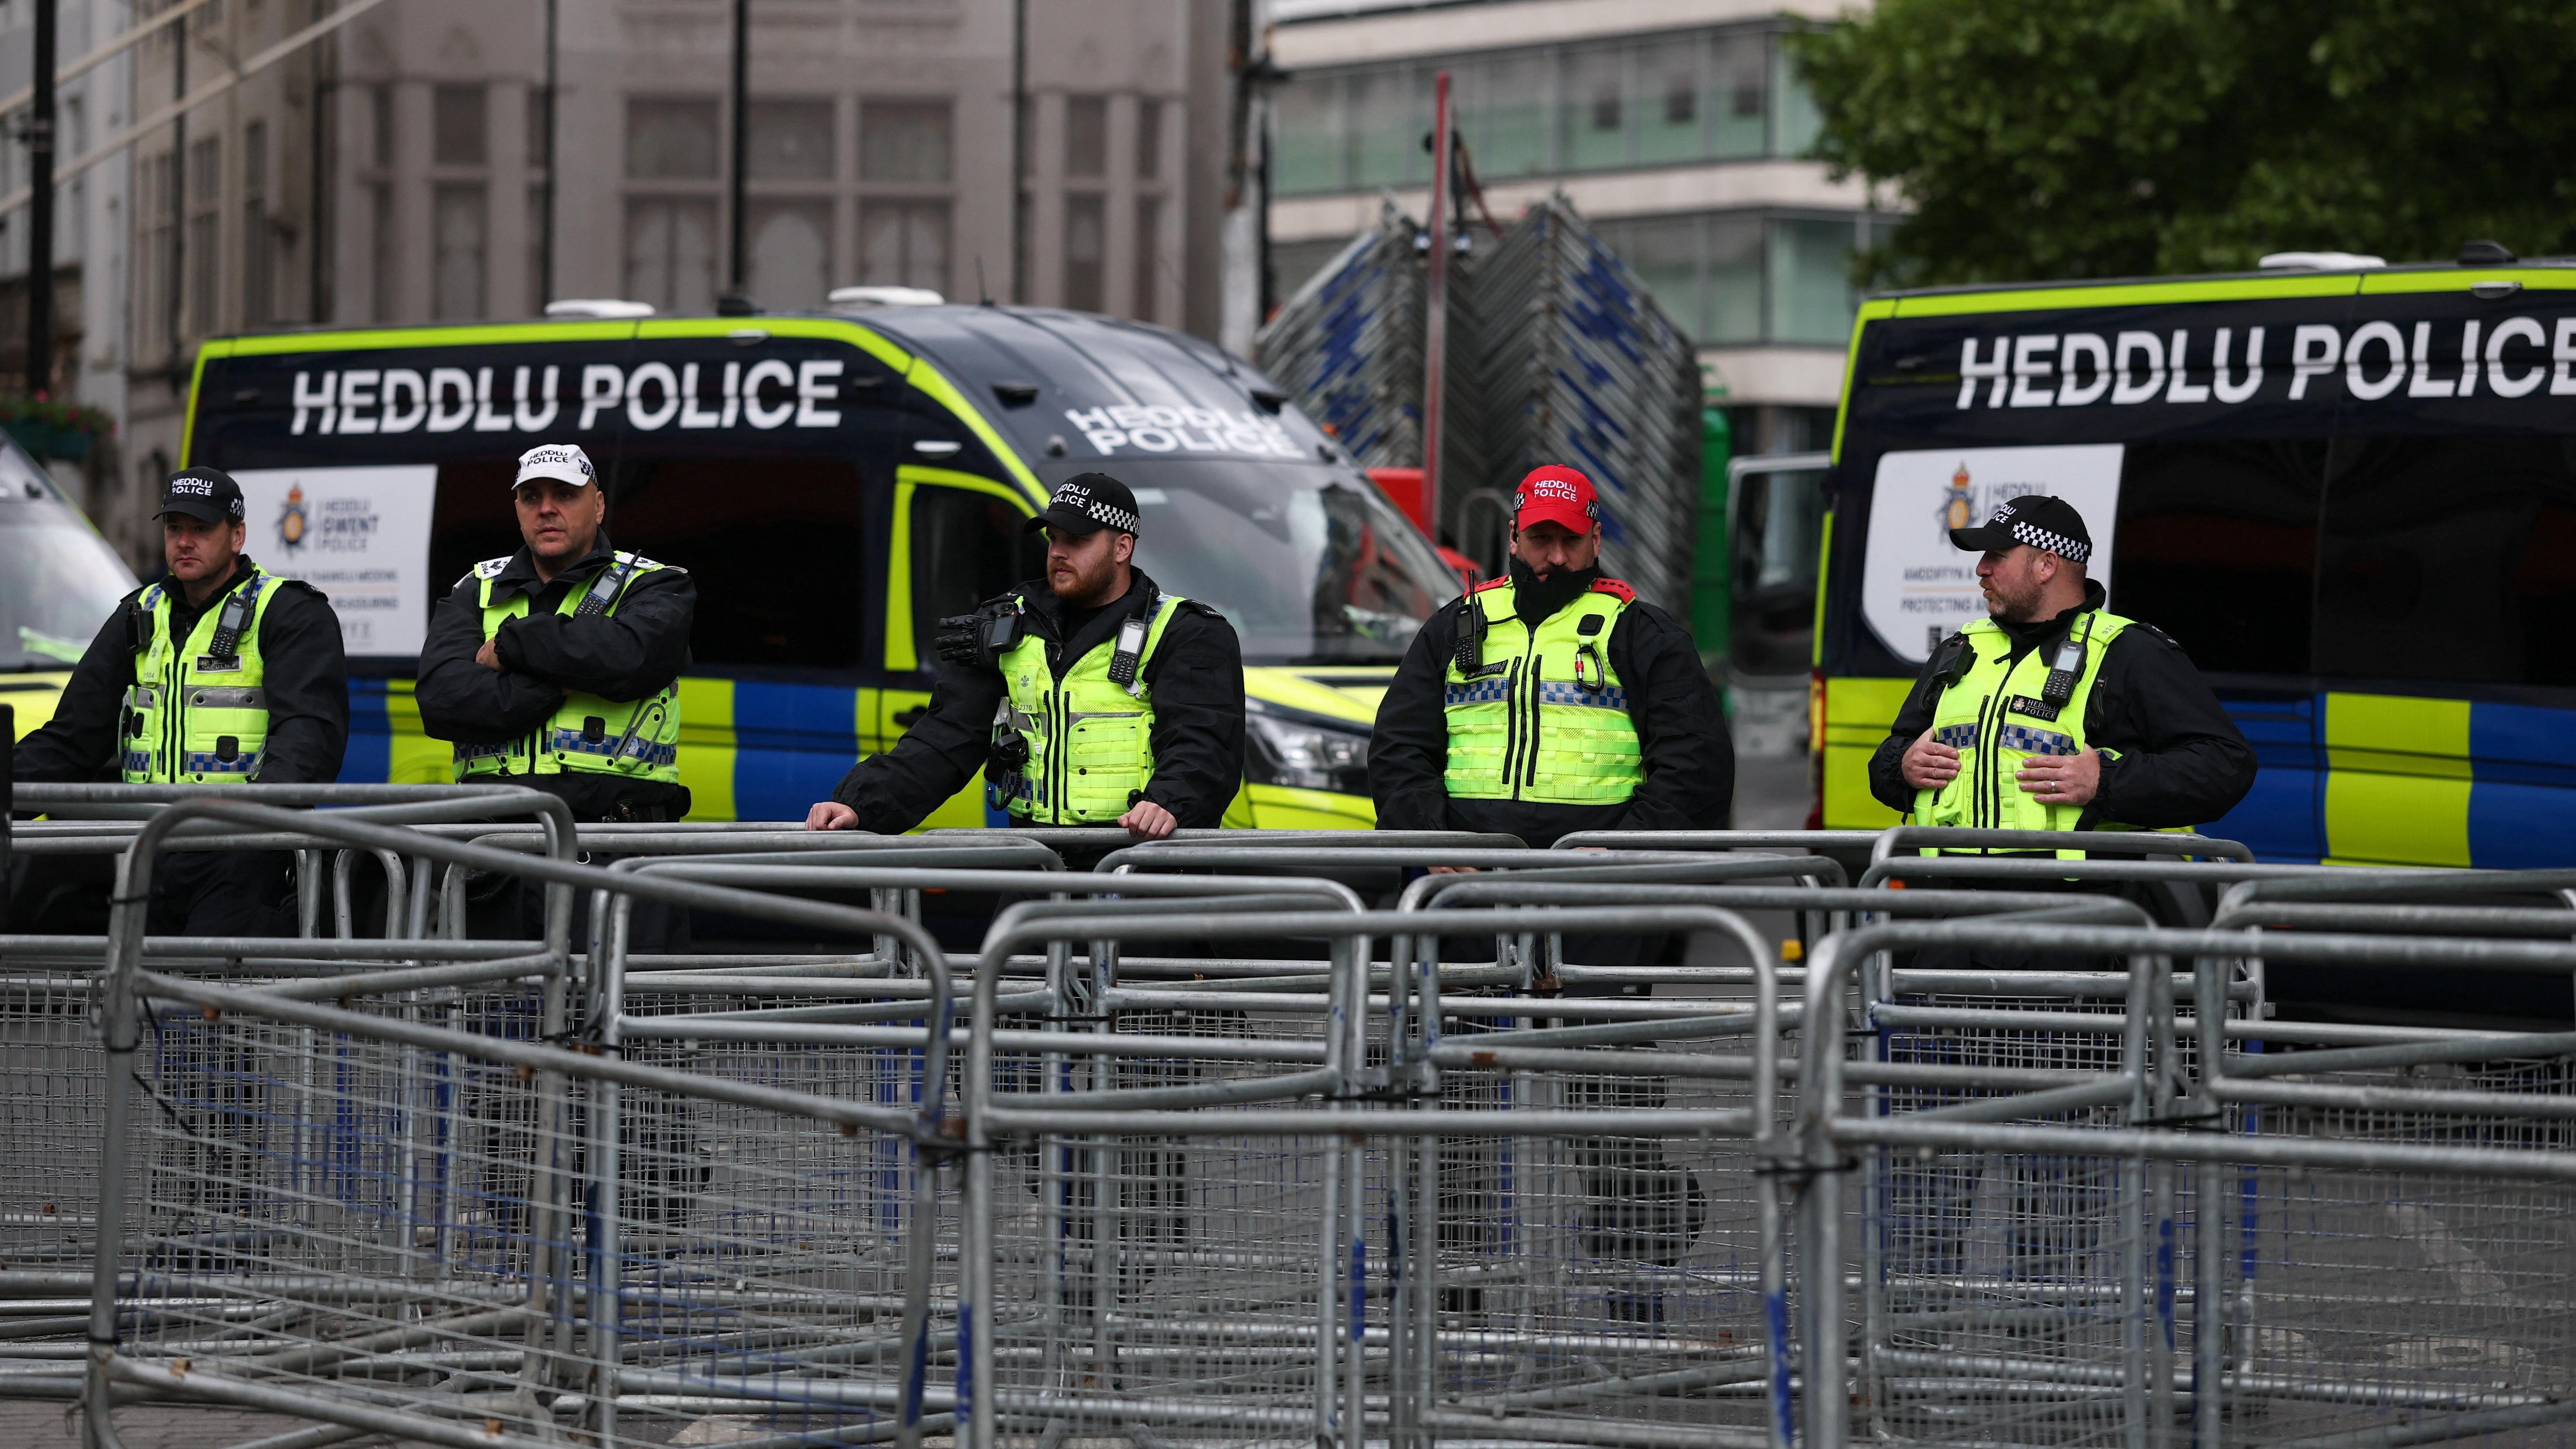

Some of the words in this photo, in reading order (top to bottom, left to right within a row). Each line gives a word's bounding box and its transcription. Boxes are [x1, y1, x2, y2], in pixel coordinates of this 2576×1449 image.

[1956, 326, 2265, 409] HEDDLU
[291, 366, 559, 434] HEDDLU
[579, 360, 844, 430] POLICE
[1086, 428, 1306, 459] POLICE
[530, 450, 568, 460] HEDDLU
[527, 457, 568, 467] POLICE
[172, 478, 213, 488] HEDDLU
[1535, 480, 1576, 492] HEDDLU
[172, 486, 212, 496] POLICE
[1534, 489, 1577, 502] POLICE
[1050, 494, 1086, 507] POLICE
[2102, 624, 2115, 634] 931
[2024, 707, 2056, 719] POLICE
